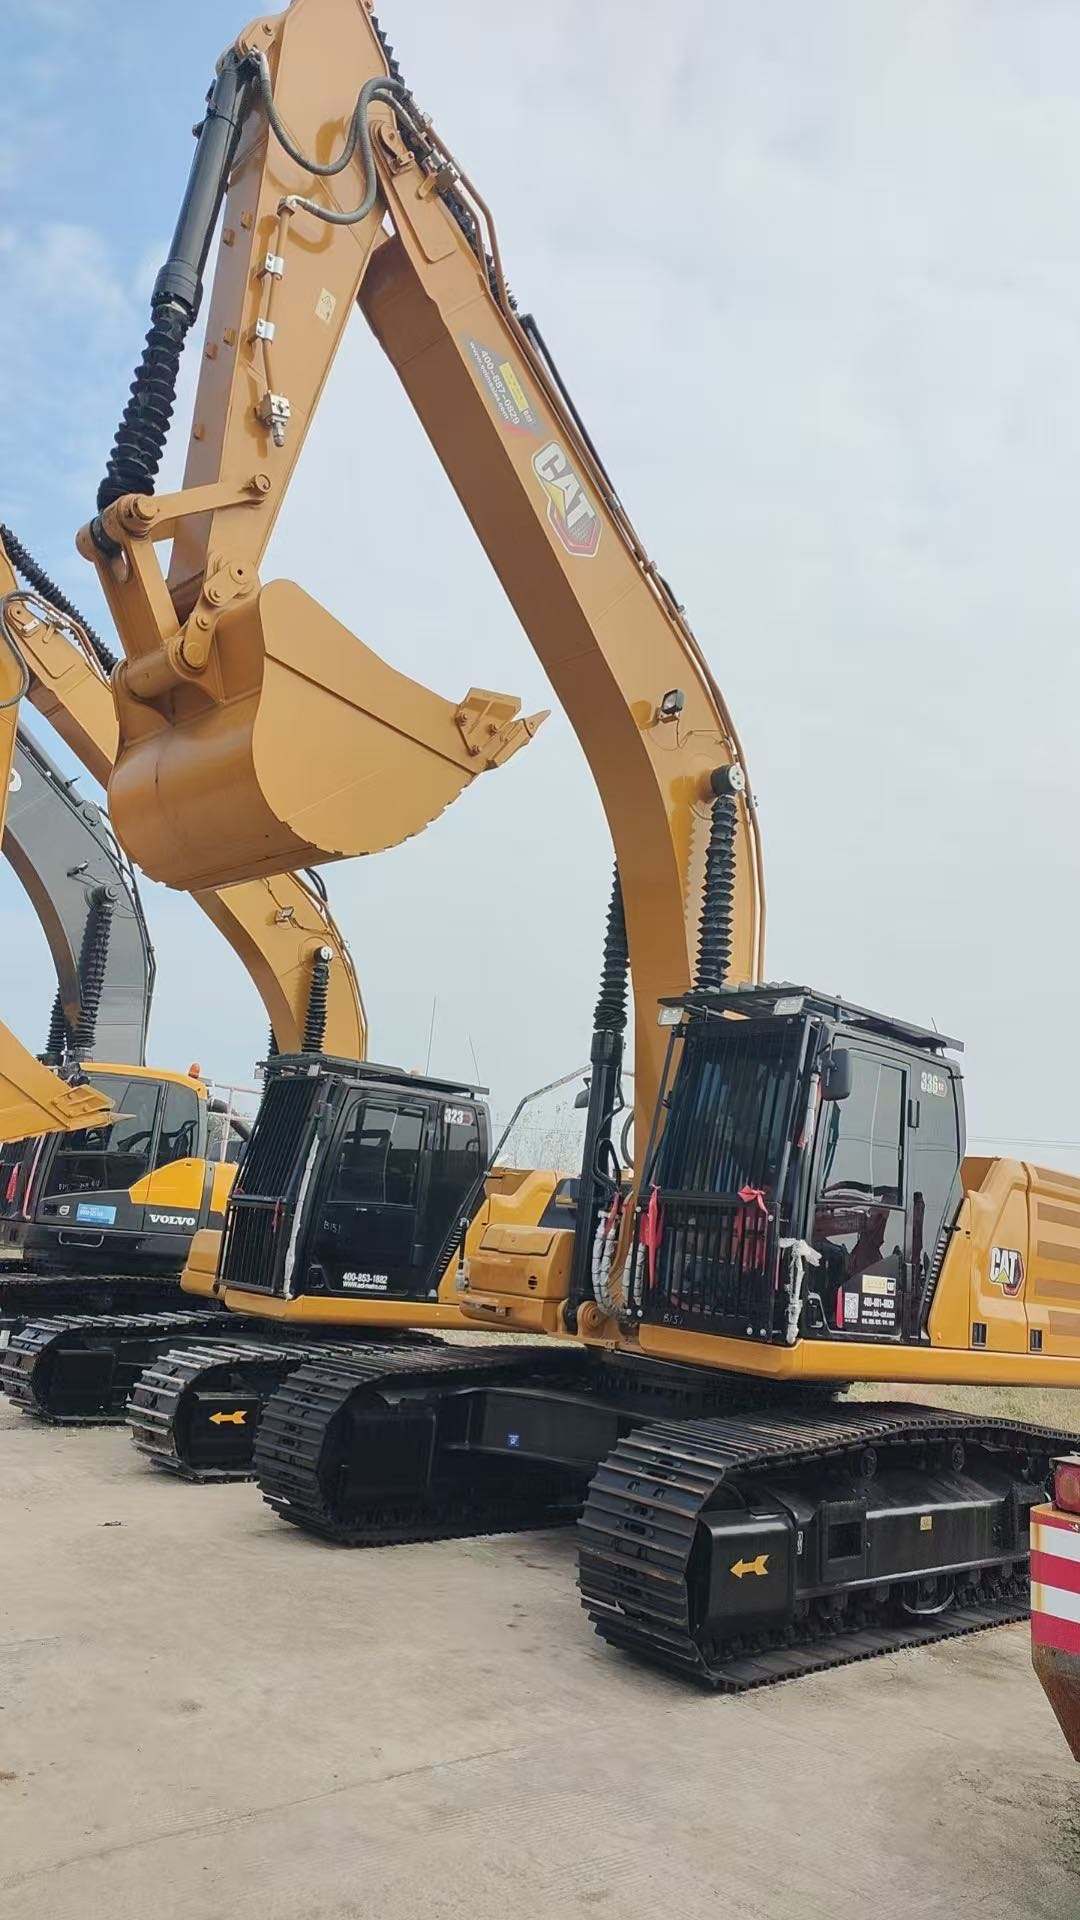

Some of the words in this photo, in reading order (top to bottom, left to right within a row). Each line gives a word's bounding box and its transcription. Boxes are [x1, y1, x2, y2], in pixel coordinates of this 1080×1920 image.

[534, 441, 597, 529] CAT
[920, 1071, 939, 1095] 336
[443, 1108, 464, 1124] 323
[149, 1214, 196, 1226] VOLVO
[990, 1247, 1018, 1285] CAT
